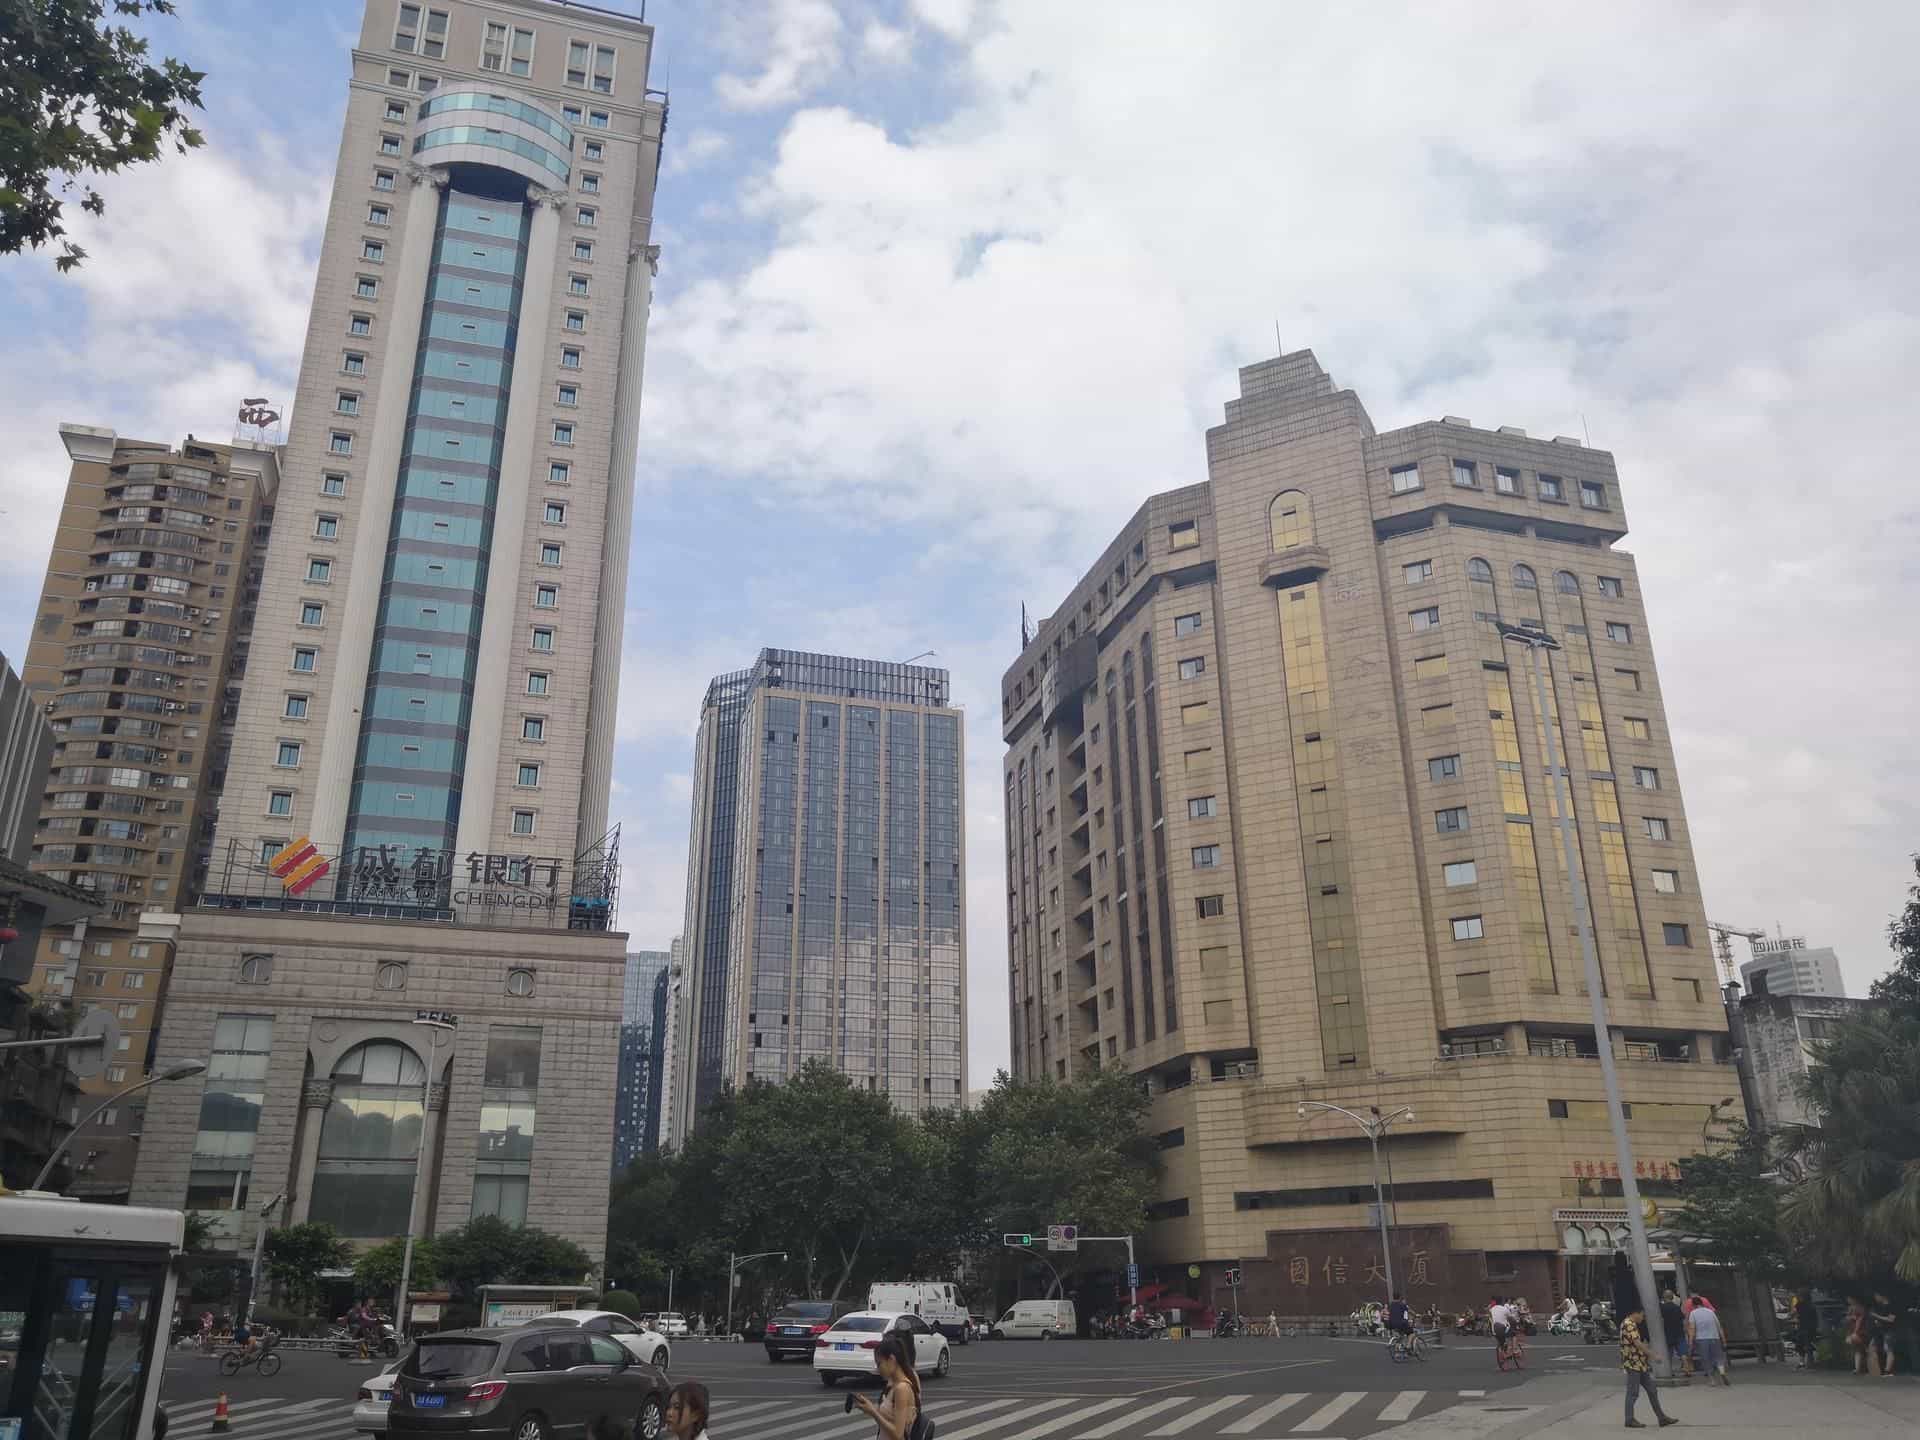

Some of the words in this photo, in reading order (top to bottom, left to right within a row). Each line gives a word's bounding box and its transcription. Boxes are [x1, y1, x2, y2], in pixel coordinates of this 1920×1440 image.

[354, 844, 564, 888] 成都银行
[454, 890, 556, 910] CHENGDU
